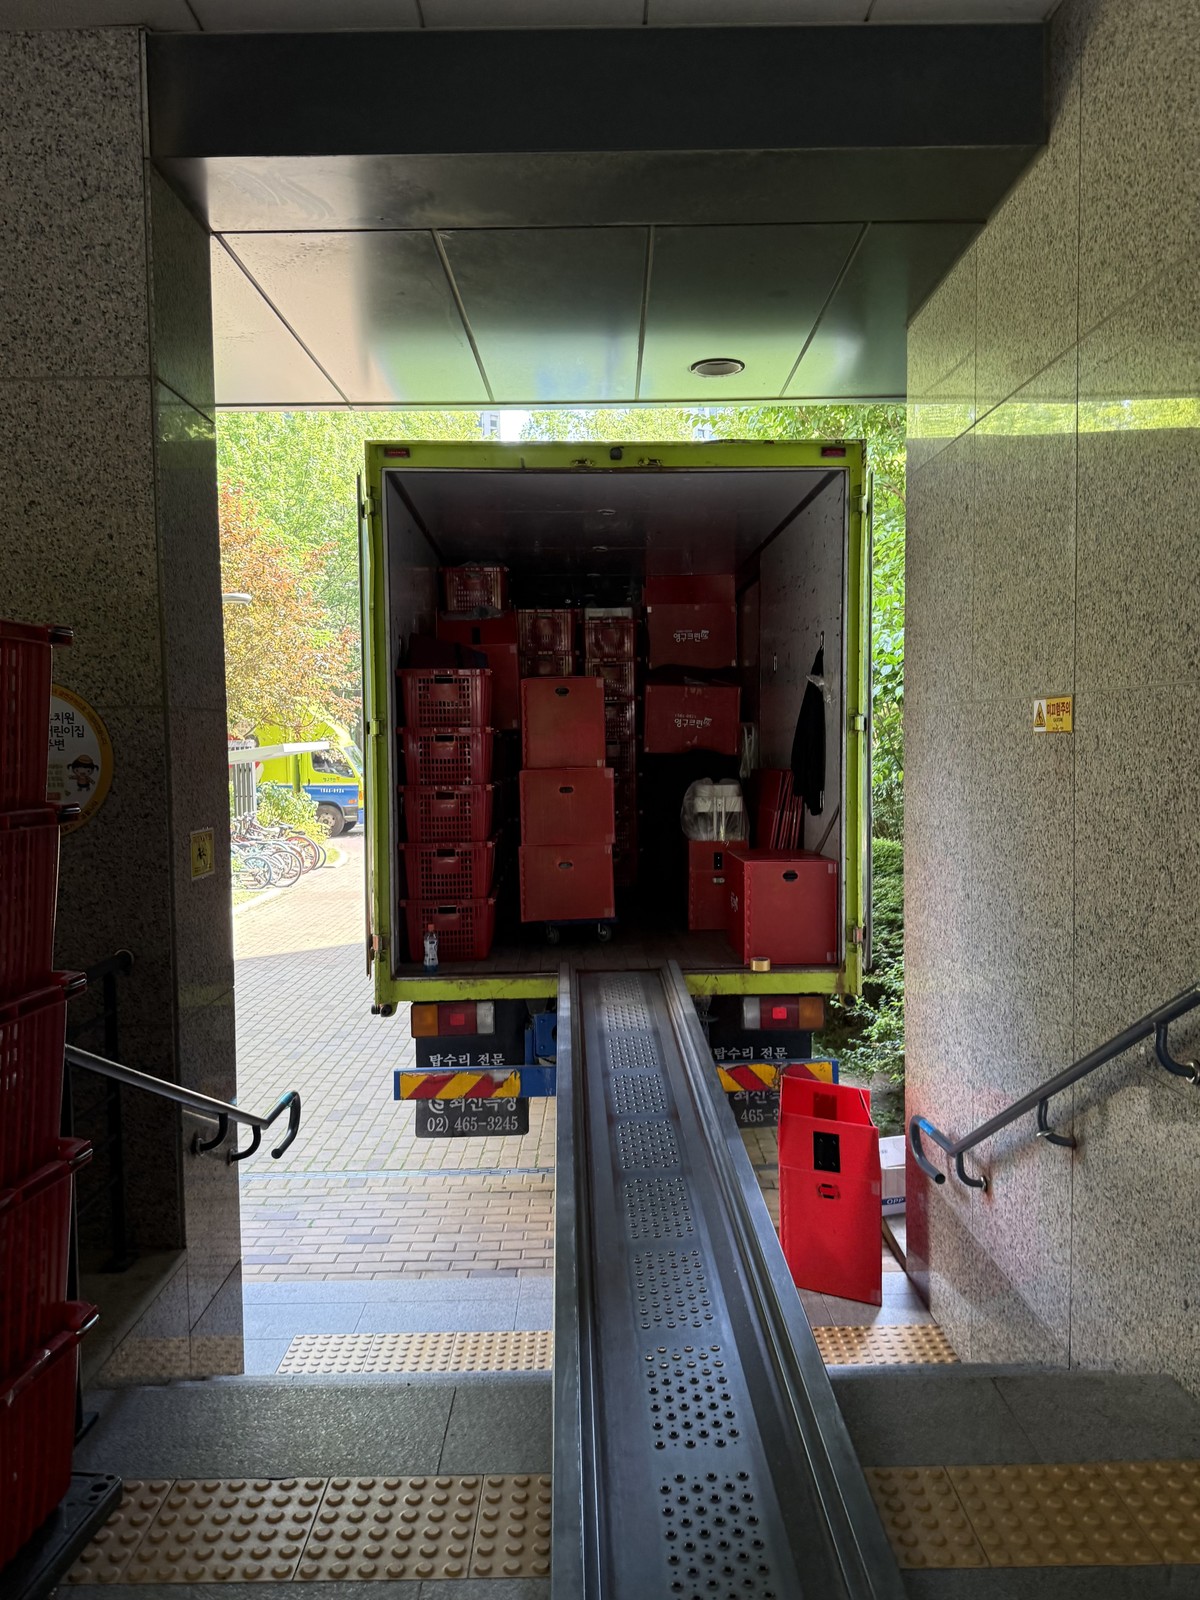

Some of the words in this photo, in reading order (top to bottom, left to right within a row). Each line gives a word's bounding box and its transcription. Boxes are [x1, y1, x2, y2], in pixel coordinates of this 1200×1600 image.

[1047, 701, 1070, 717] 미끄럼주의
[50, 711, 75, 724] 치원
[428, 1052, 471, 1067] 탑수리
[477, 1052, 506, 1066] 전문
[713, 1046, 754, 1060] 탑수리
[760, 1046, 788, 1060] 전문
[427, 1116, 449, 1133] 02)
[454, 1115, 518, 1132] 465-3245
[886, 1197, 904, 1205] OPP
